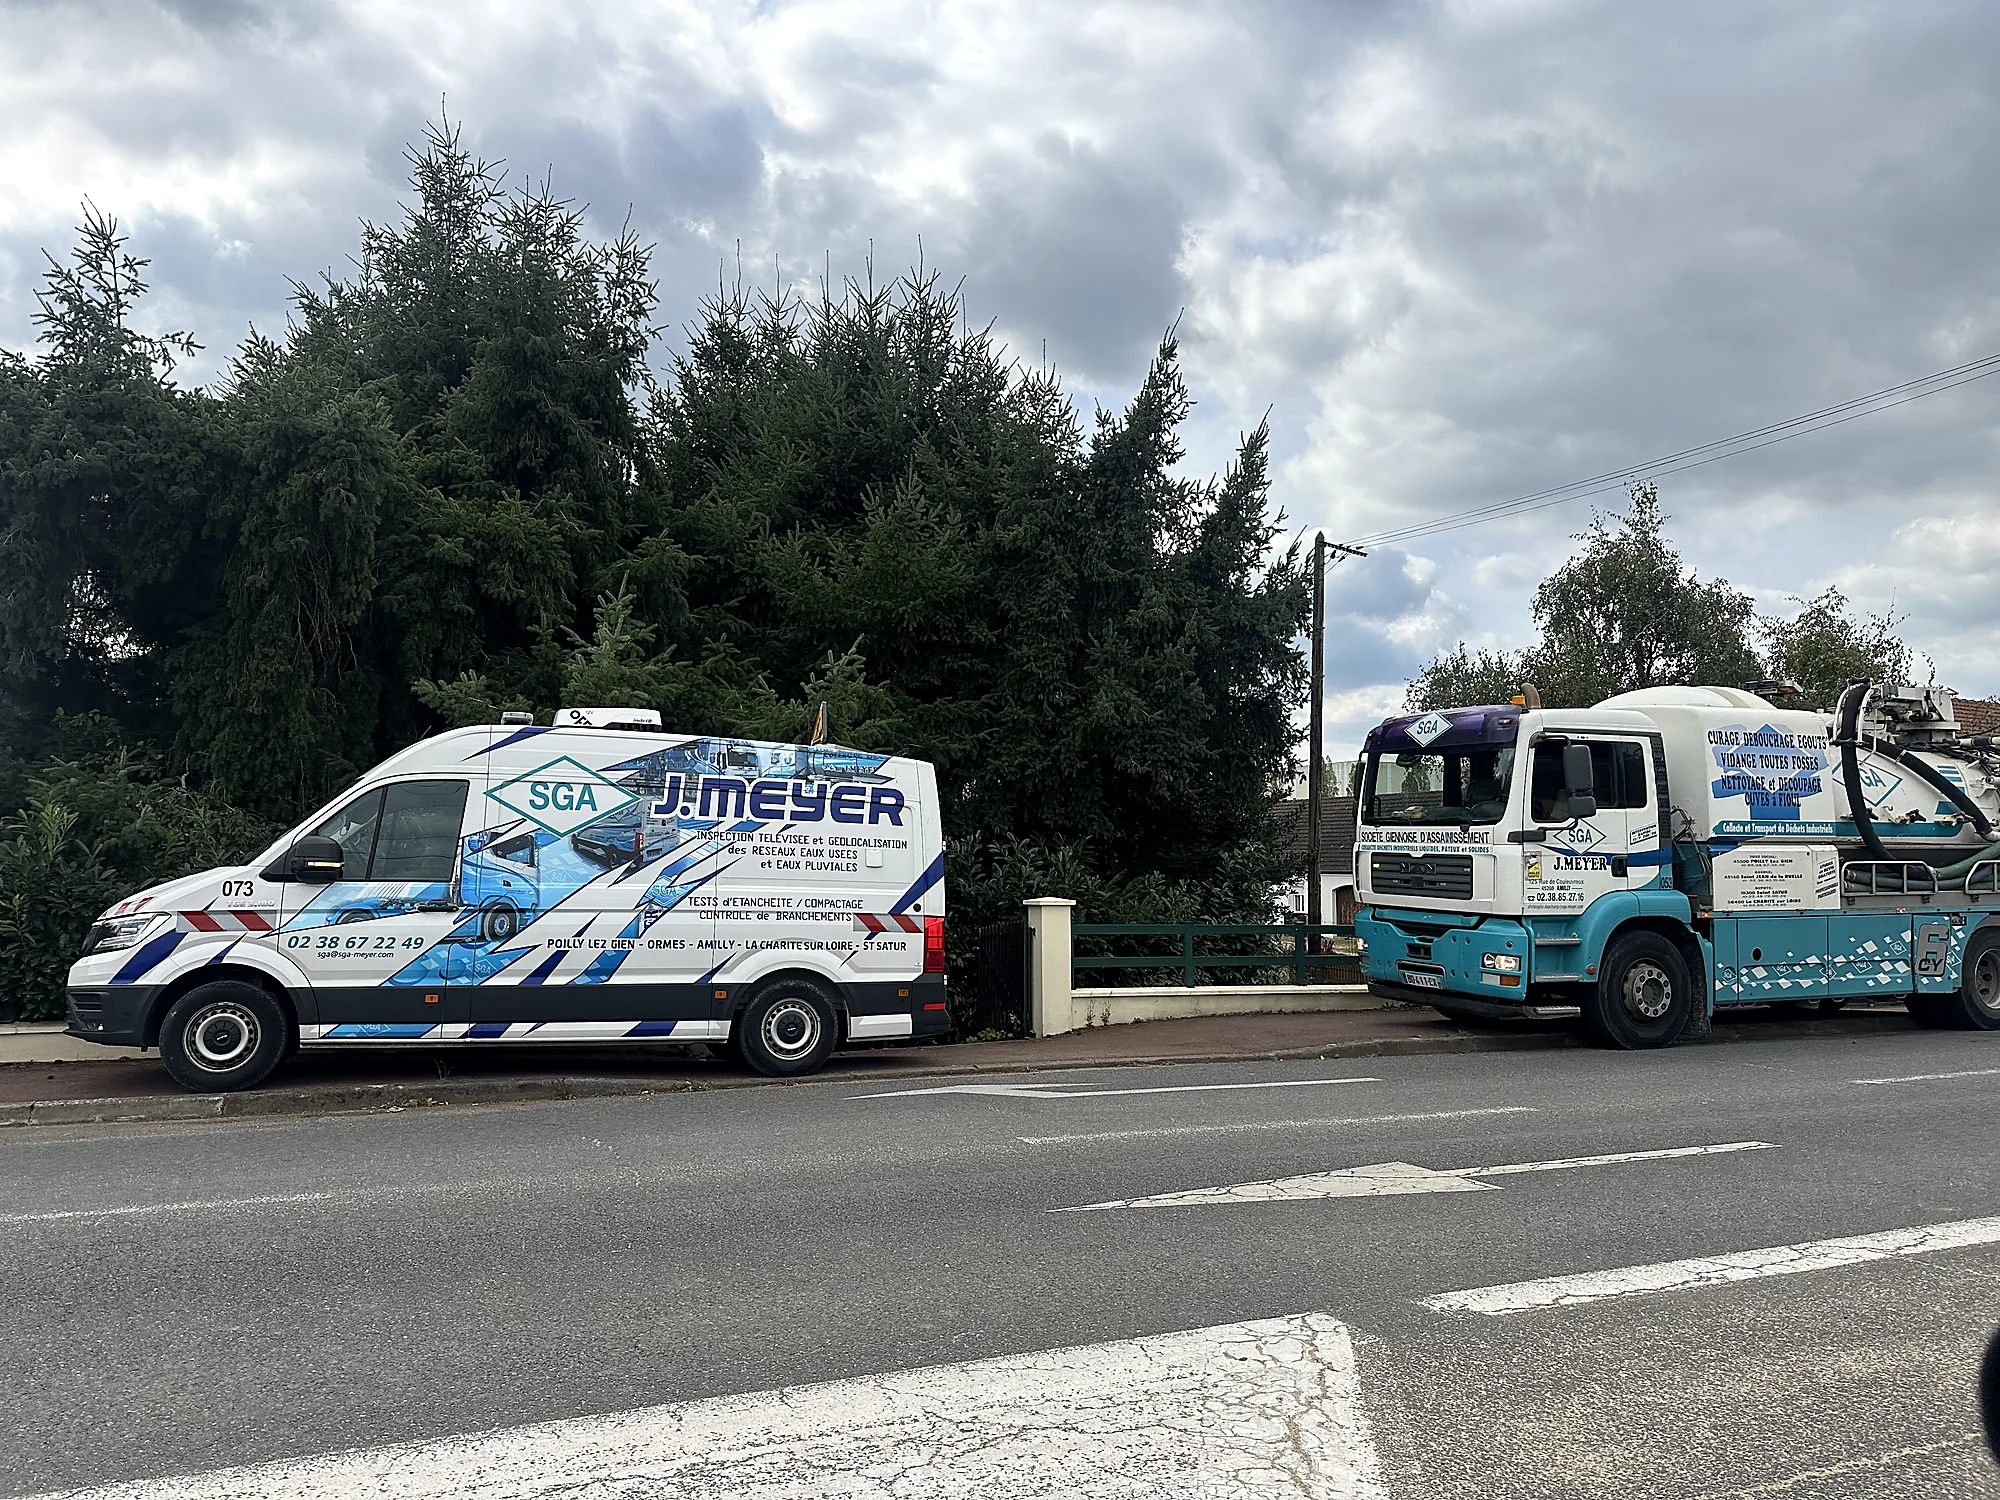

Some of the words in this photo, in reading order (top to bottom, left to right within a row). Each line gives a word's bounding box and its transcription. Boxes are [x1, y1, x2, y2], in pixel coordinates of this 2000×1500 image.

[1416, 720, 1438, 735] SGA
[1707, 730, 1740, 746] CURAGE
[1743, 732, 1795, 748] DEBOUCHAGE
[1797, 735, 1827, 749] EGOUTS
[1720, 752, 1757, 768] VIDANGE
[1760, 754, 1789, 769] TOUTES
[1791, 756, 1819, 770] FOSSES
[1720, 775, 1766, 791] NETTOYAGE
[1768, 779, 1776, 791] et
[1778, 777, 1823, 792] DECOUPAGE
[1859, 768, 1887, 788] GA
[528, 780, 598, 812] SGA
[653, 774, 905, 827] J.MEYER
[1744, 792, 1770, 807] CUVES
[1779, 793, 1801, 807] FIOUL
[696, 831, 754, 843] INSPECTION
[812, 836, 824, 845] et
[828, 837, 908, 849] GEOLOCALISATION
[1568, 829, 1593, 843] SGA
[727, 845, 747, 855] des
[752, 846, 796, 857] RESEAUX
[800, 848, 825, 858] EAUX
[828, 849, 858, 860] USEES
[760, 860, 773, 869] et
[777, 860, 801, 870] EAUX
[805, 861, 858, 872] PLUVIALES
[1553, 857, 1607, 871] J.MEYER
[551, 872, 568, 883] SGA
[222, 880, 254, 897] 073
[652, 885, 677, 896] SGA
[687, 897, 719, 907] TESTS
[722, 897, 793, 908] d'ETANCHEITE
[804, 899, 863, 909] COMPACTAGE
[699, 911, 752, 920] CONTROLE
[756, 911, 770, 920] de
[776, 912, 852, 922] BRANCHEMENTS
[287, 936, 311, 949] 02
[315, 936, 340, 949] 38
[345, 936, 369, 949] 67
[372, 937, 397, 949] 22
[401, 937, 425, 950] 49
[546, 939, 585, 949] POILLY
[588, 939, 607, 949] LEZ
[611, 939, 635, 949] GIEN
[647, 940, 686, 949] ORMES
[697, 940, 736, 950] AMILLY
[745, 940, 758, 950] LA
[759, 940, 802, 950] CHARITE
[803, 941, 824, 951] SUR
[825, 941, 853, 951] LOIRE
[862, 941, 876, 951] ST
[876, 941, 907, 951] SATUR
[317, 951, 394, 960] sga@sga-meyer.com
[475, 963, 491, 974] SGA
